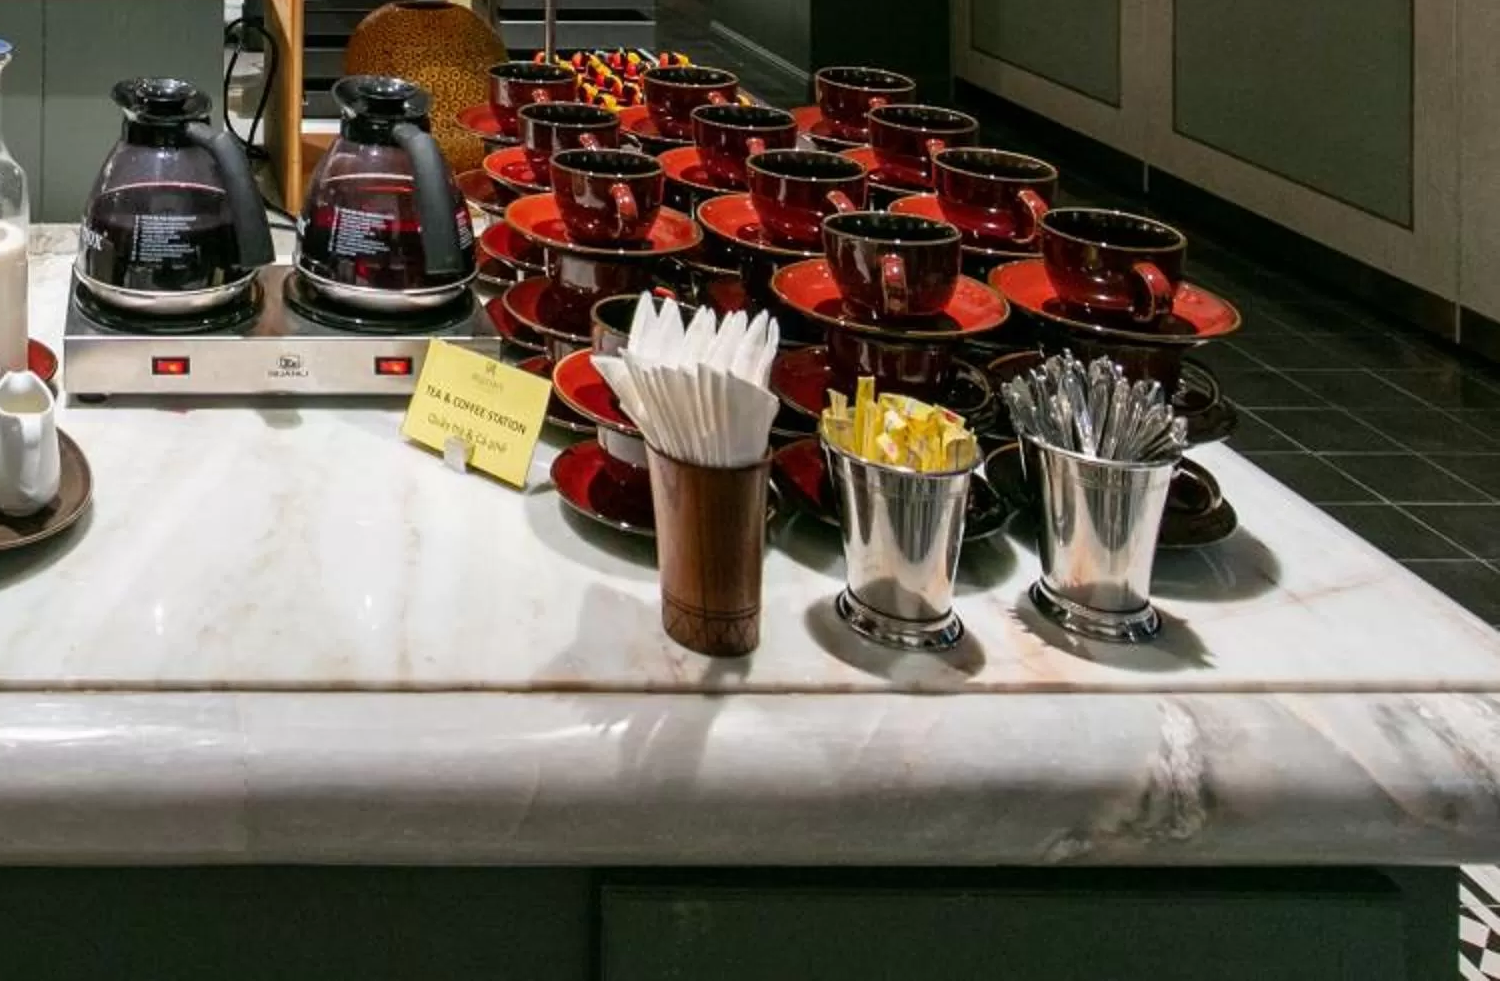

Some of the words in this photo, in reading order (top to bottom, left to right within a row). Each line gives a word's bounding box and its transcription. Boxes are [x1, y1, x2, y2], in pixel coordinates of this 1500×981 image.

[426, 384, 442, 400] TEA
[443, 392, 451, 404] &
[453, 396, 487, 419] COFFEE
[487, 410, 527, 436] STATION
